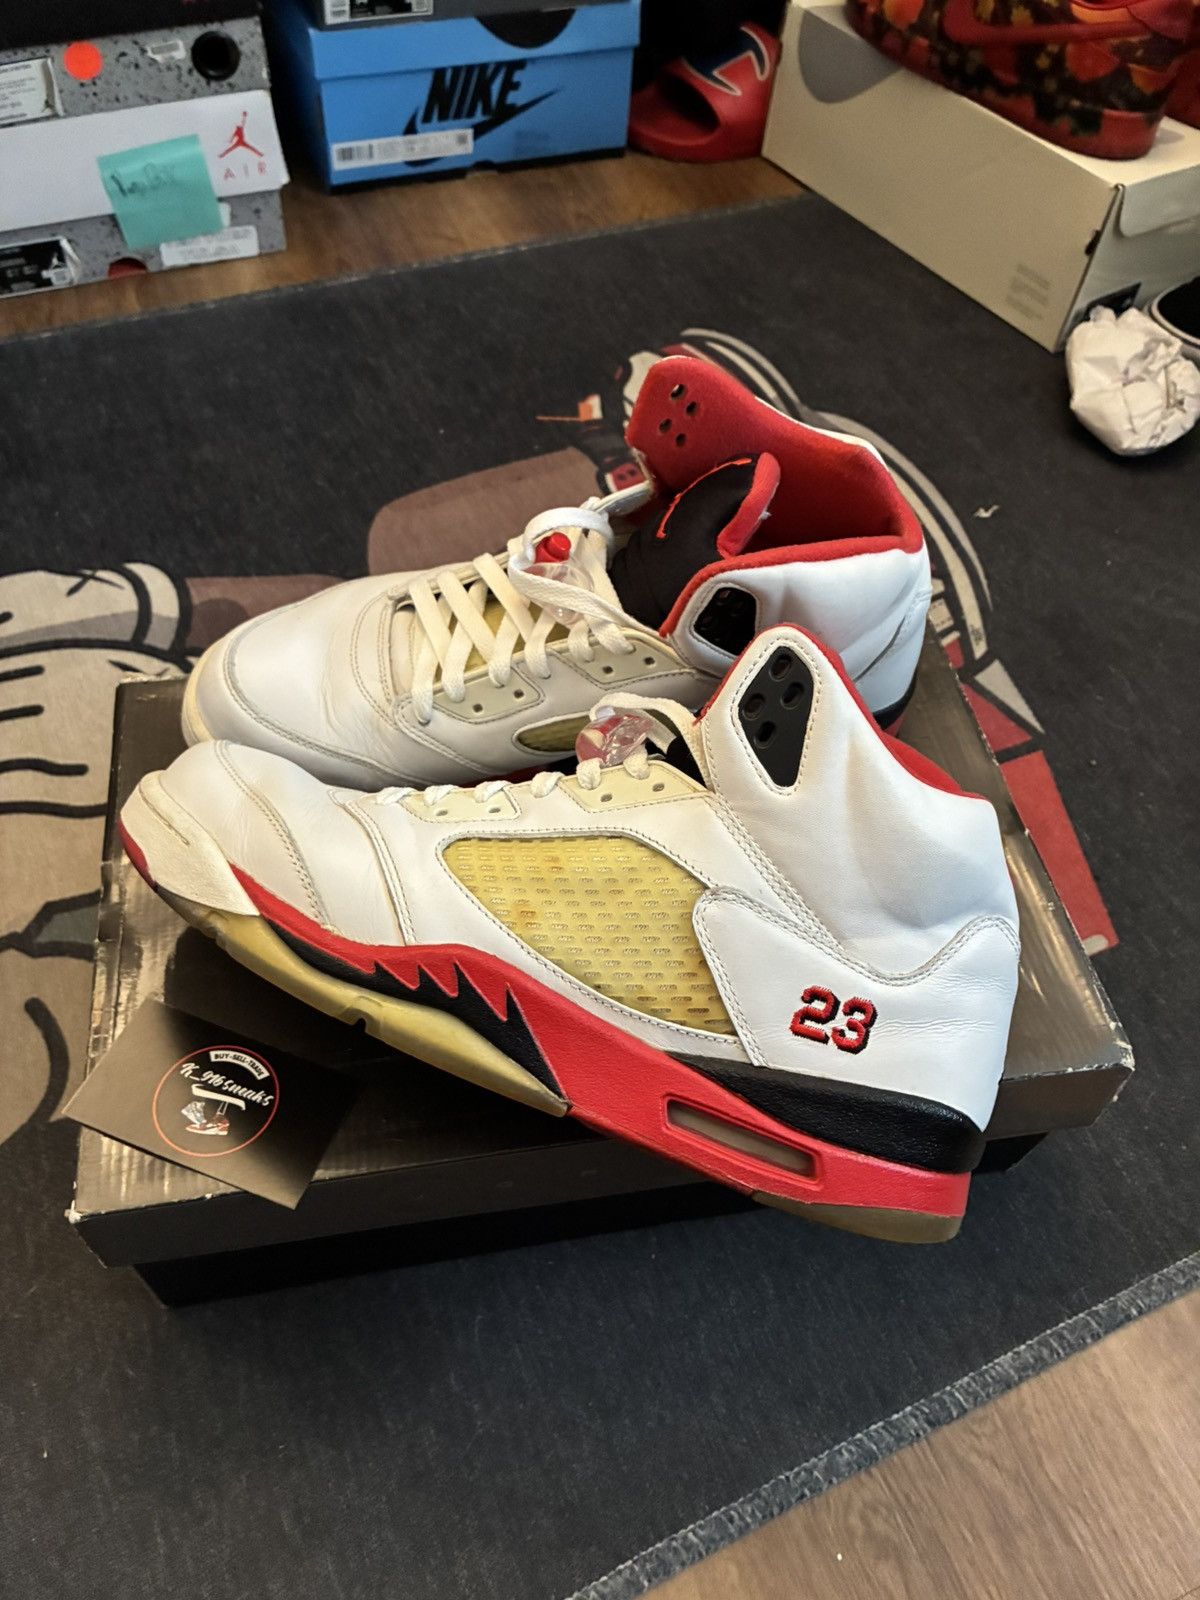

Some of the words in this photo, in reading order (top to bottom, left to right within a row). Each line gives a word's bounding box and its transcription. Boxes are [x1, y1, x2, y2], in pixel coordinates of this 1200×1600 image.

[421, 60, 527, 124] NIKE
[223, 161, 267, 180] AIR
[789, 985, 878, 1055] 23
